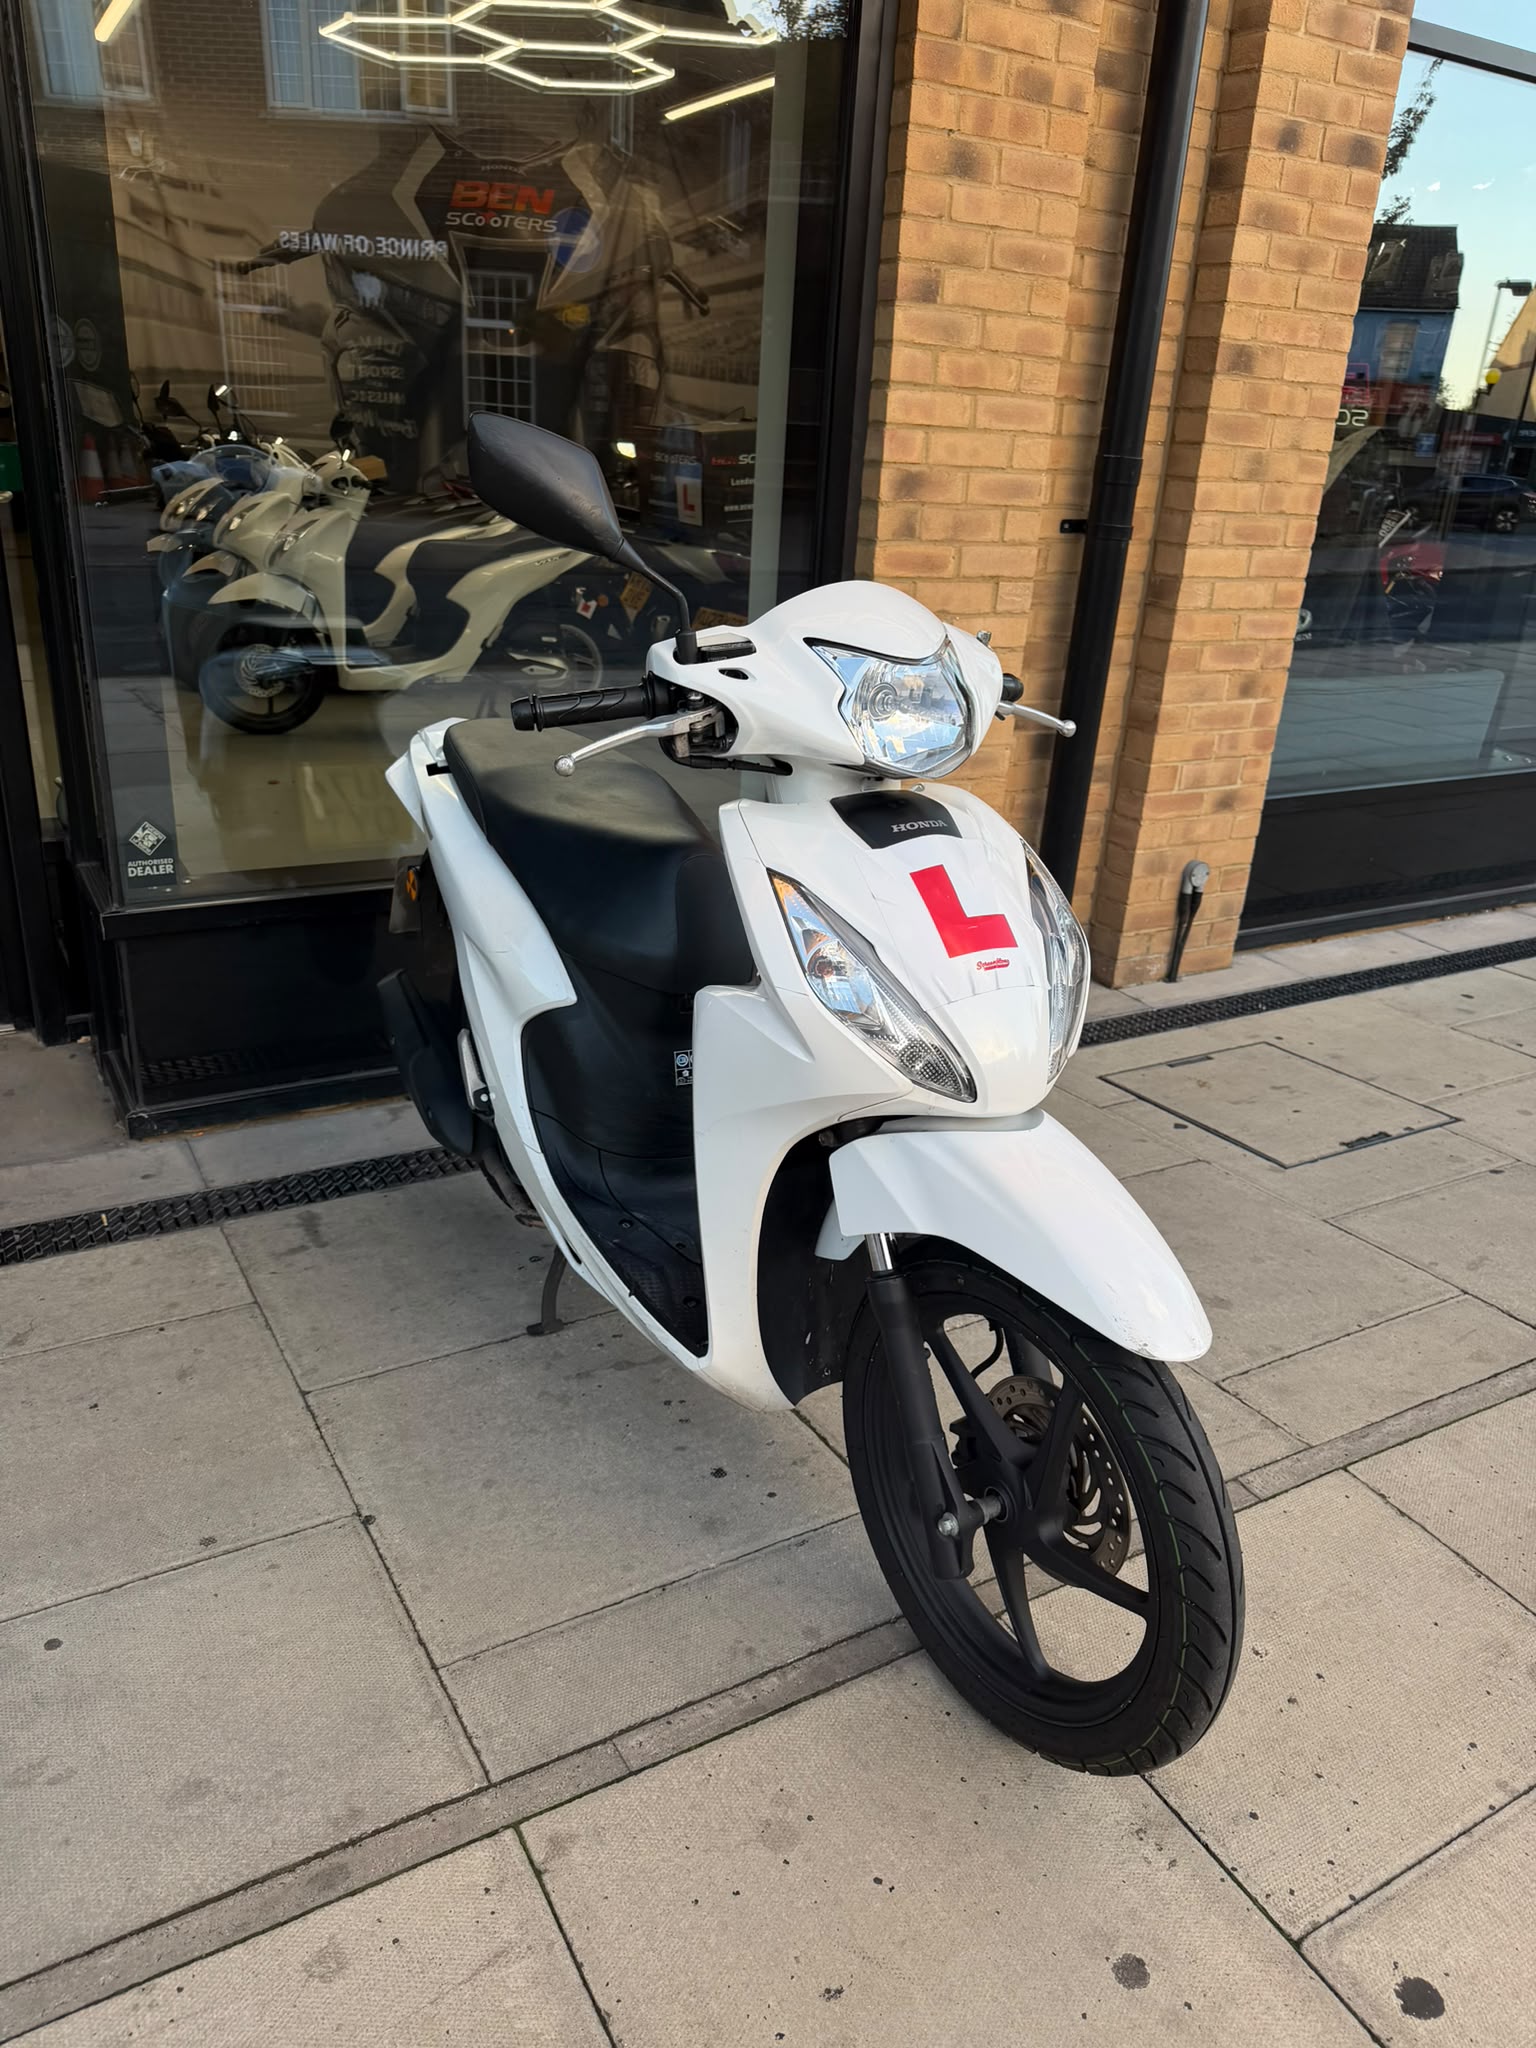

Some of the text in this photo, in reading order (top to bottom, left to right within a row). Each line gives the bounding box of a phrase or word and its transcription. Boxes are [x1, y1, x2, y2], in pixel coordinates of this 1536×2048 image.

[450, 179, 556, 215] BEN
[683, 483, 696, 513] L
[890, 819, 948, 833] HONDA
[127, 857, 174, 867] AUTHORISED
[127, 864, 175, 878] DEALER
[909, 864, 1019, 959] L
